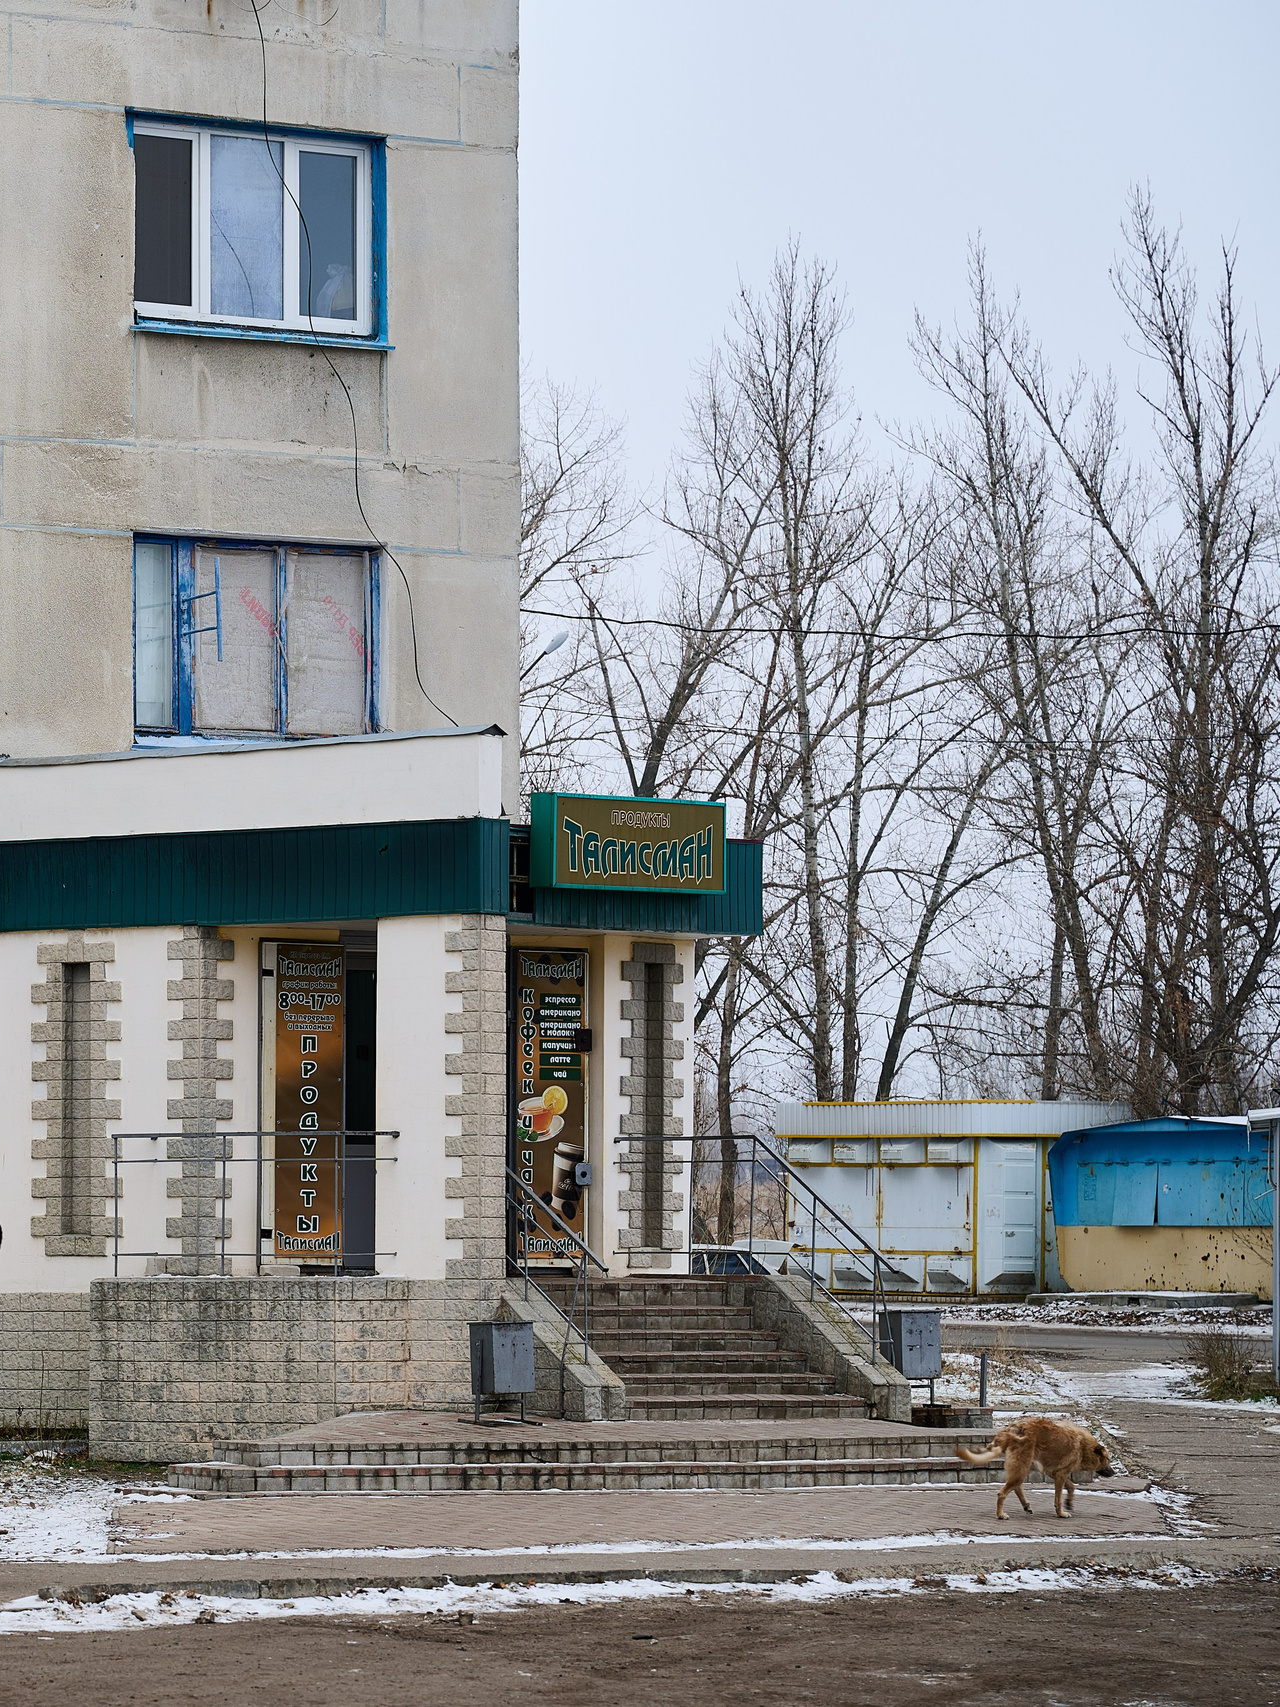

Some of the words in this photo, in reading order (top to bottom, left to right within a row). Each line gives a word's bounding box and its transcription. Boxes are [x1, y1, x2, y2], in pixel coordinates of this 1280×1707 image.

[611, 809, 671, 828] ПРОДУКТЫ
[563, 816, 714, 885] ТАЛИСМАН
[278, 954, 342, 978] ТАЛИСМАН
[520, 954, 583, 979] ТАЛИСМАН
[282, 980, 309, 990] график
[544, 996, 576, 1005] эспрессо
[284, 1011, 297, 1020] без
[298, 1013, 335, 1023] перерыва
[540, 1008, 581, 1018] американо
[294, 1023, 332, 1031] выходных
[540, 1021, 581, 1030] американо
[550, 1055, 571, 1064] латте
[553, 1070, 567, 1078] чай
[296, 1034, 320, 1233] ПРОДУКТЫ
